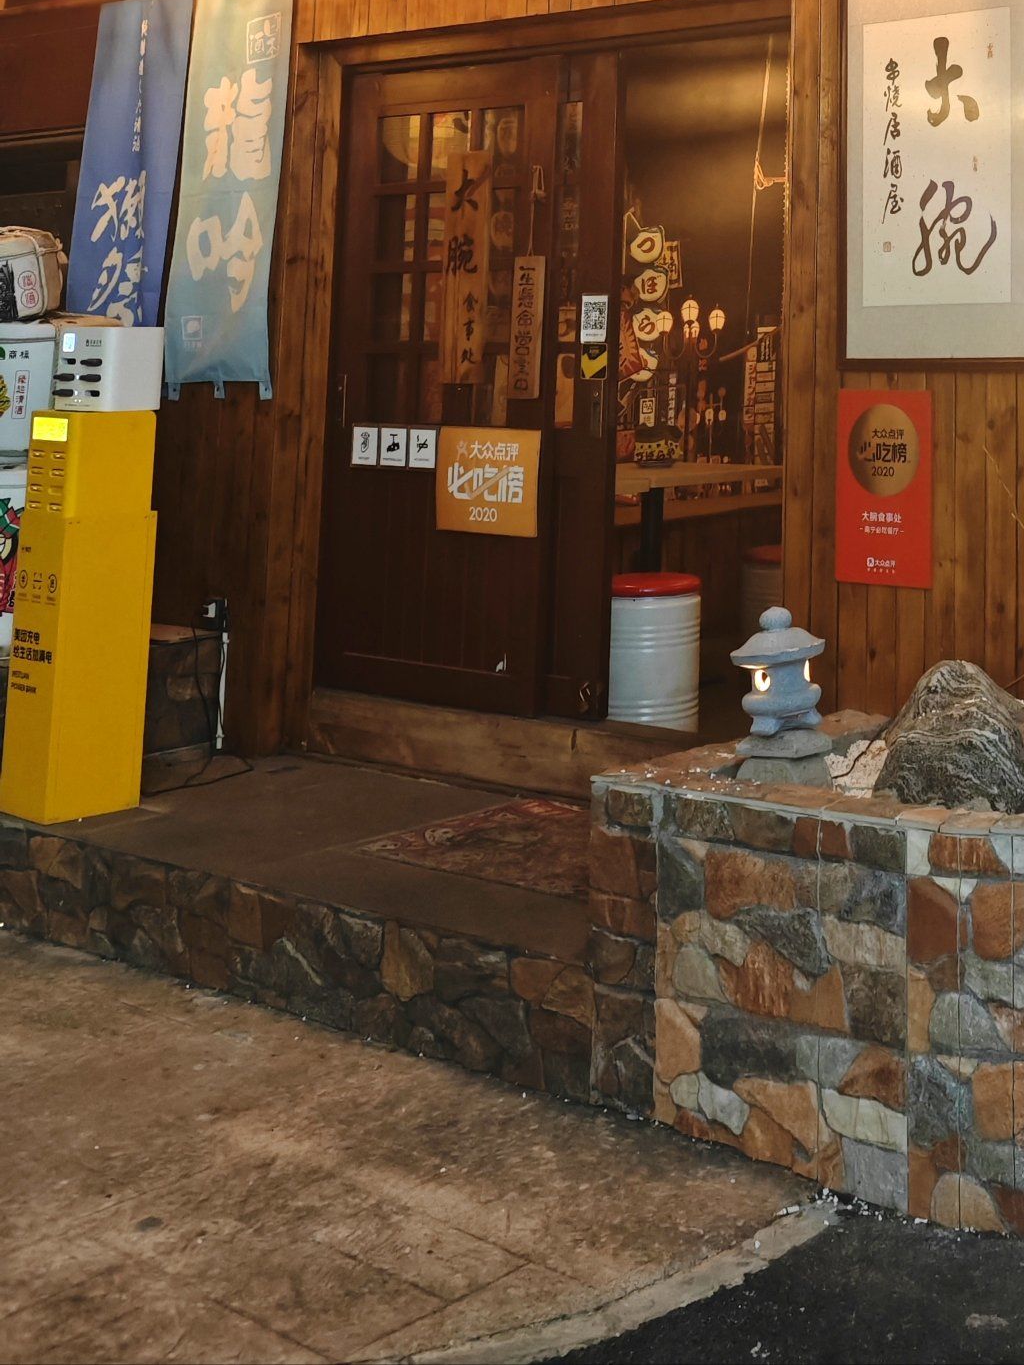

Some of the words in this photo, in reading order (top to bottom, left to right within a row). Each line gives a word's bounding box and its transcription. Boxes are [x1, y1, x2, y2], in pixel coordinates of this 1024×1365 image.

[872, 428, 905, 440] 大众点评
[469, 440, 519, 462] 大众点评
[858, 441, 908, 464] 必吃榜
[871, 466, 895, 477] 2020
[447, 462, 524, 504] 必吃榜
[469, 506, 498, 523] 2020
[14, 627, 41, 646] 美团充电
